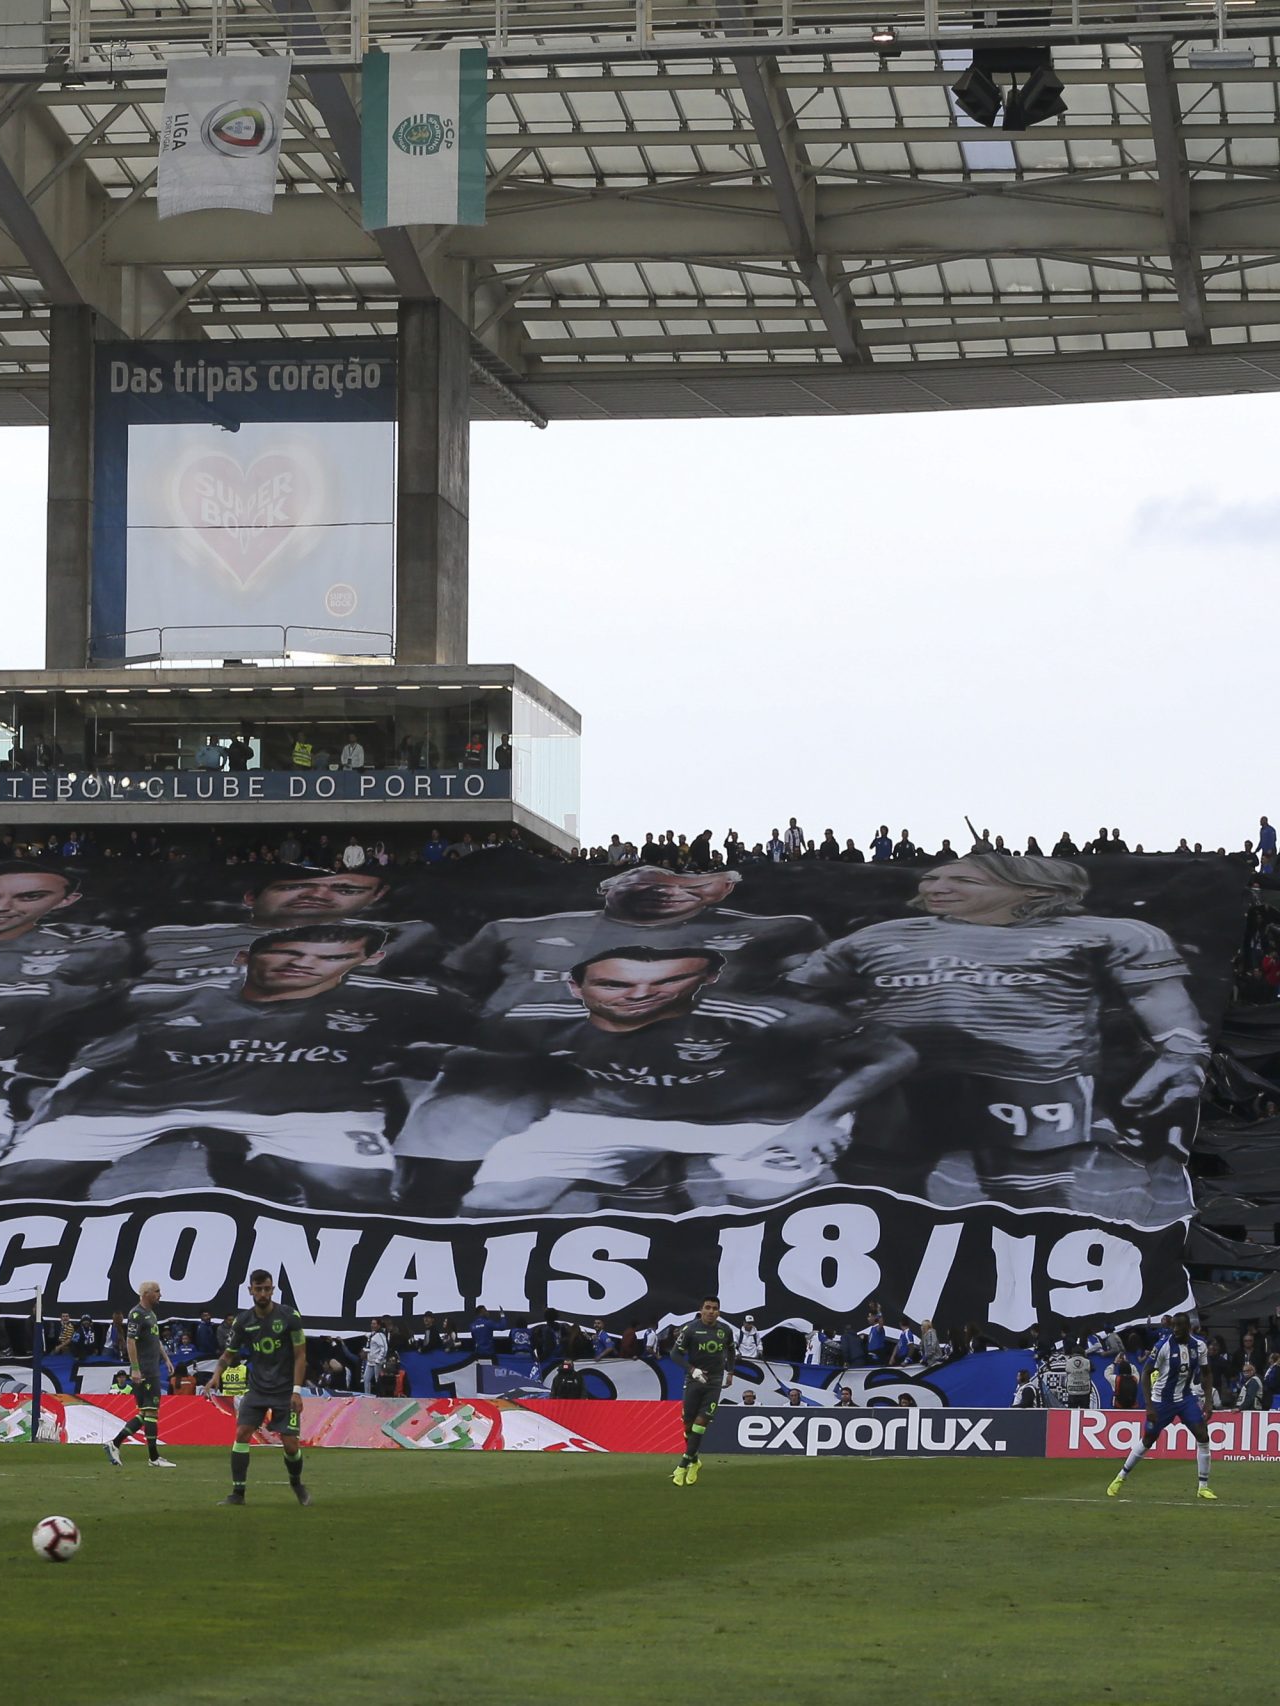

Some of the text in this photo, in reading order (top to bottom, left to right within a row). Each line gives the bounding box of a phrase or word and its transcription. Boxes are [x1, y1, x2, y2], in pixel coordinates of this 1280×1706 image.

[172, 113, 189, 151] LIGA
[443, 118, 455, 149] SCP
[110, 356, 381, 402] Das tripas coração
[146, 777, 265, 798] CLUBE
[289, 776, 336, 797] DO
[360, 774, 485, 797] PORTO
[166, 1046, 348, 1066] Emirates
[987, 1102, 1075, 1137] 99
[718, 1203, 1143, 1333] 18/19
[252, 1337, 282, 1354] NOS
[698, 1340, 723, 1353] NOS
[710, 1402, 717, 1414] 9
[737, 1408, 1007, 1456] exporlux.
